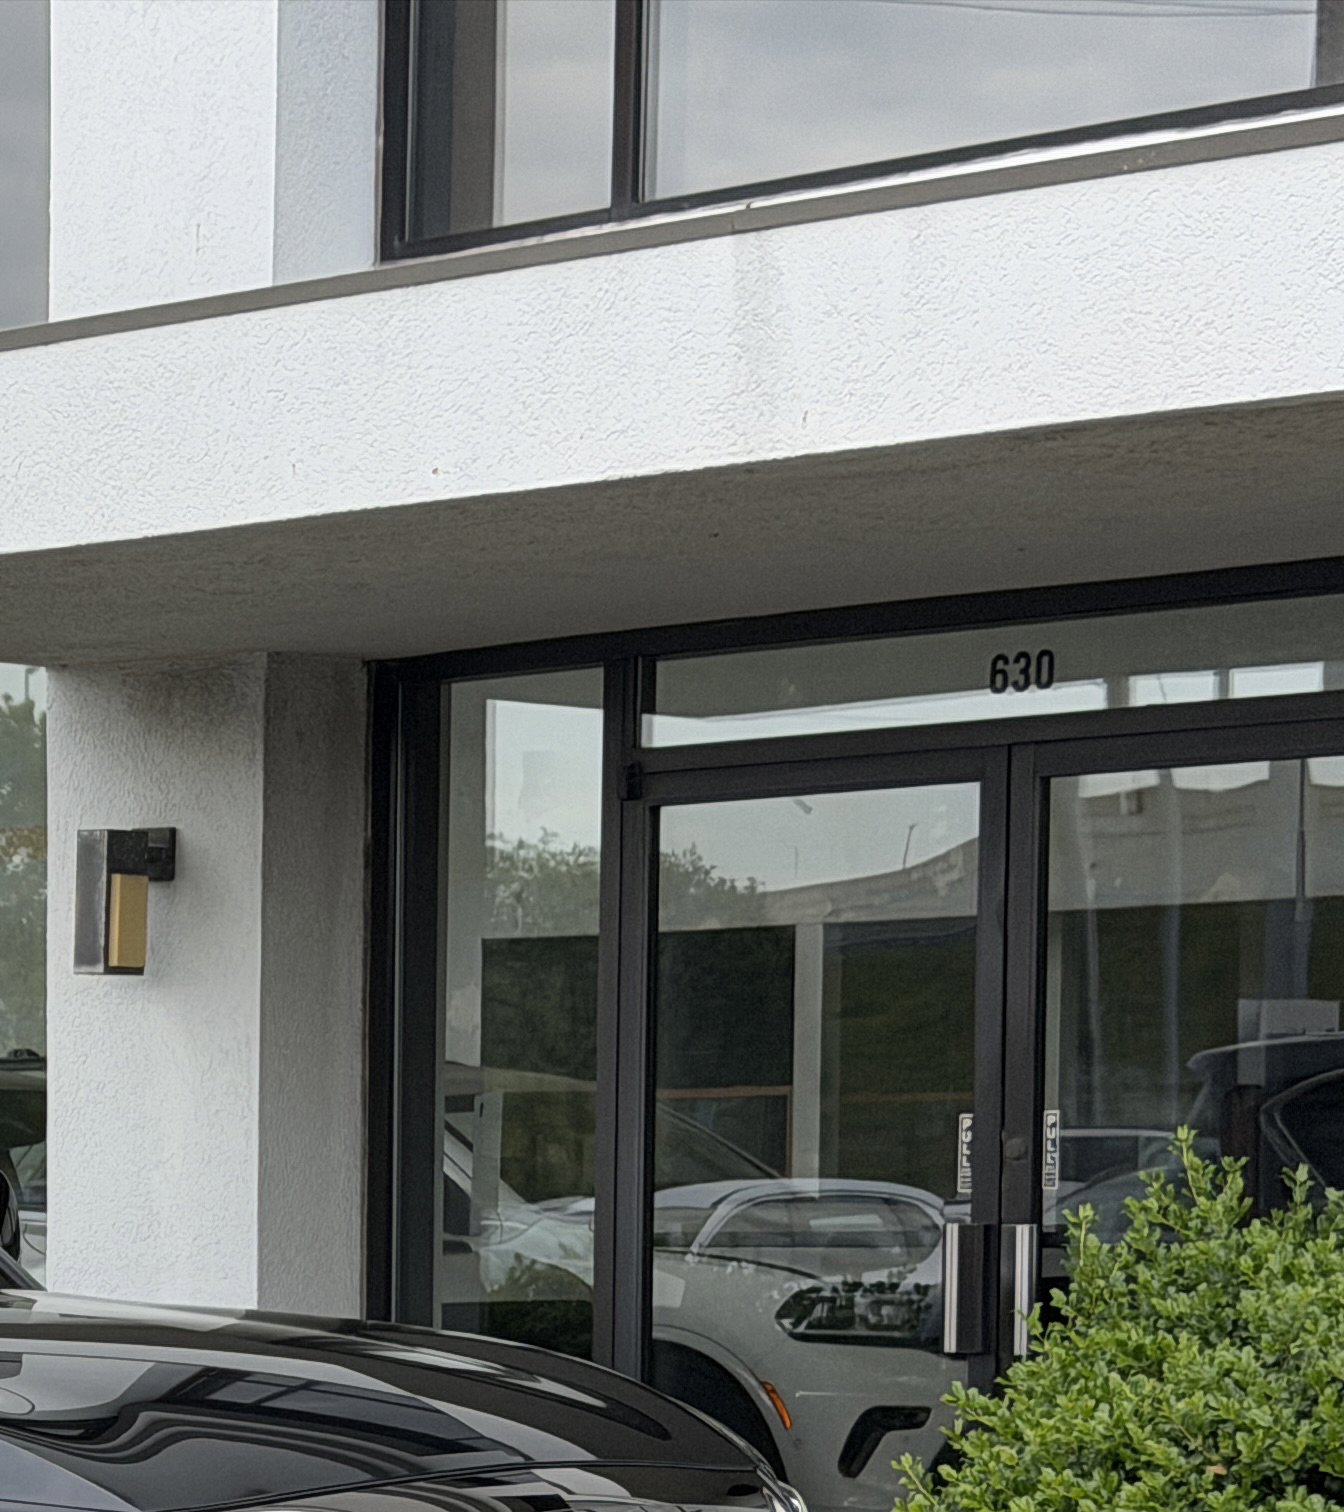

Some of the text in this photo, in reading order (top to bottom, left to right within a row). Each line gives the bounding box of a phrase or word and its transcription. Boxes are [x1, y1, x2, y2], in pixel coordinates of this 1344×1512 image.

[989, 649, 1055, 694] 630
[962, 1118, 973, 1167] PULL
[1046, 1114, 1057, 1164] PULL
